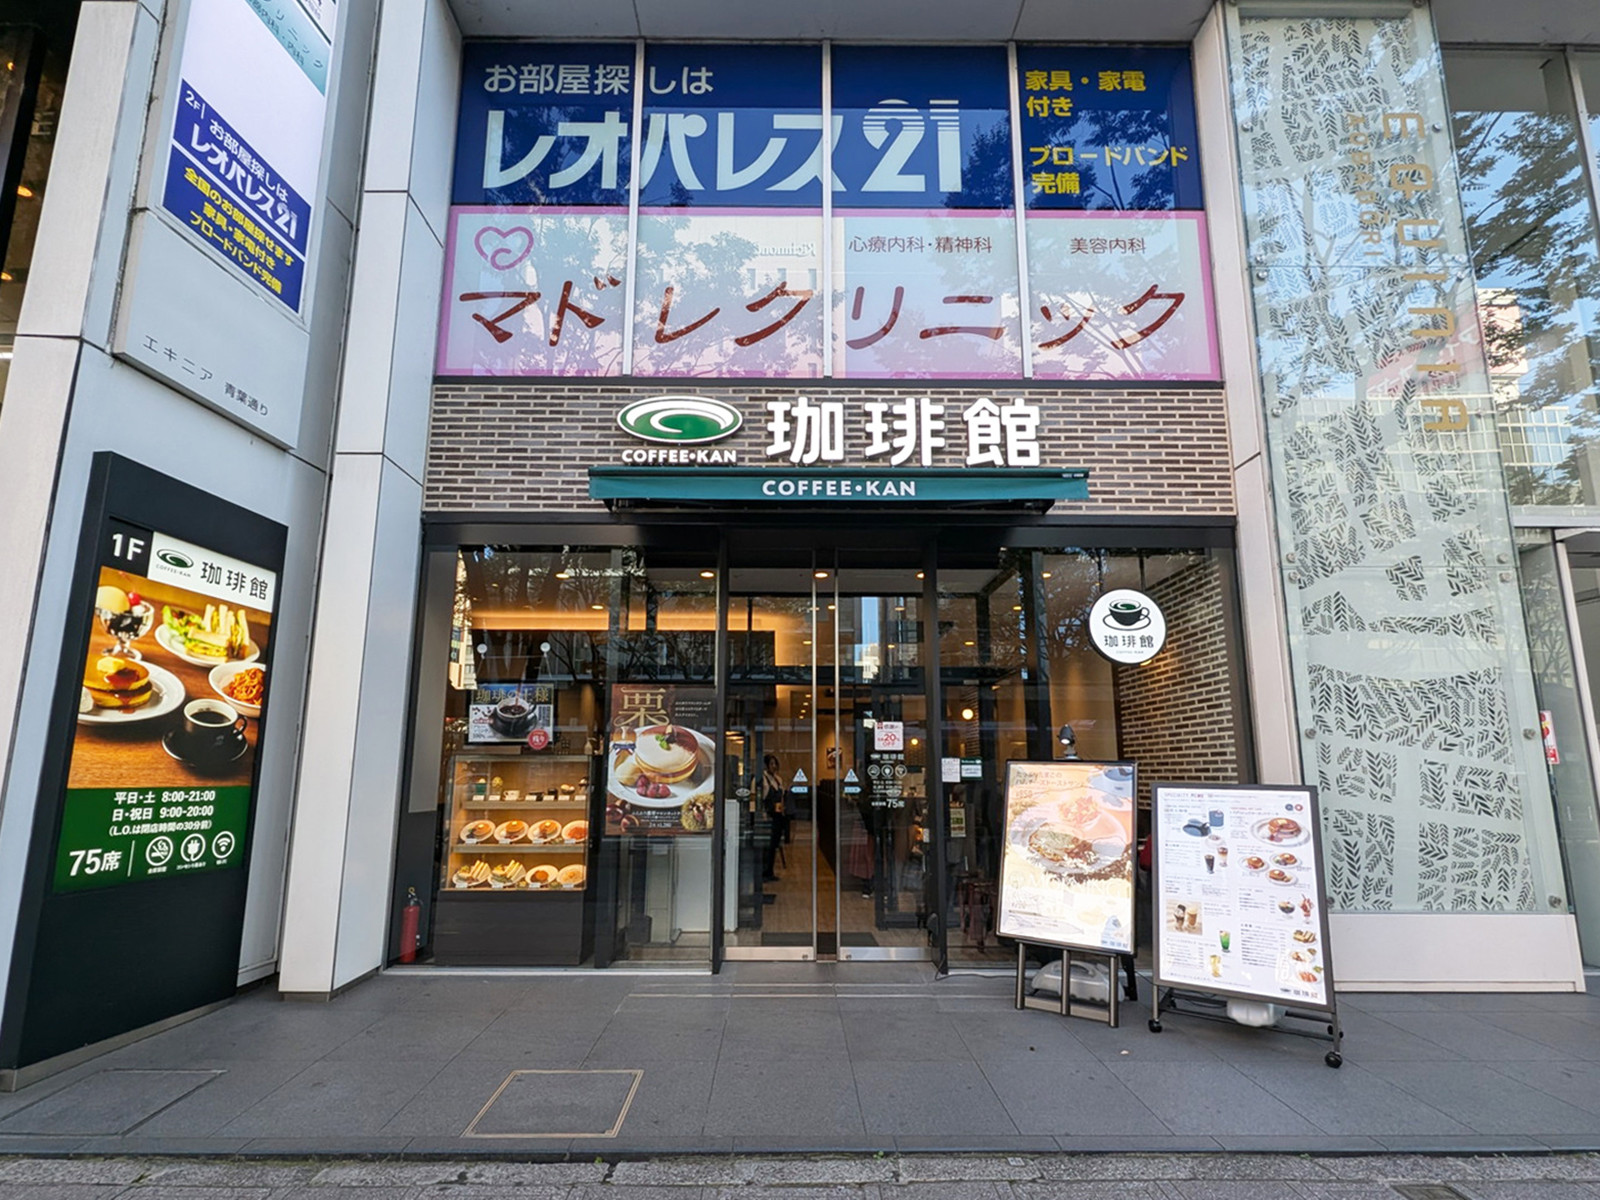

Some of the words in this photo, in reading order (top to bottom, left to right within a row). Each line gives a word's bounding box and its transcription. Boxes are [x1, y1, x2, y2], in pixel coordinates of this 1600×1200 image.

[484, 63, 714, 96] お部屋探しは
[1025, 70, 1146, 92] 家具・家電
[185, 90, 201, 110] 2F
[1026, 95, 1074, 118] 付き
[482, 99, 962, 192] レオパレス21
[1029, 147, 1188, 167] ブロードバンド
[209, 118, 288, 202] お部屋探しは
[191, 123, 297, 240] レオパレス21
[1032, 172, 1080, 195] 完備
[190, 210, 282, 294] ブロードバンド完備
[849, 235, 993, 254] 心療内科・精神科
[1070, 237, 1147, 255] 美容内科
[459, 275, 1187, 347] マドレクリニック
[142, 334, 213, 381] エキニア
[224, 381, 269, 417] 青葉通り
[766, 395, 1042, 467] 珈琲館
[112, 533, 145, 561] 1F
[200, 561, 269, 600] 珈琲館
[1104, 634, 1154, 648] 珈琲館
[613, 686, 670, 727] 栗
[114, 791, 156, 805] 平日・土
[161, 790, 216, 804] 8:00-21:00
[112, 807, 153, 822] 日・祝日
[159, 805, 214, 819] 9:00-20:00
[68, 848, 122, 877] 75席
